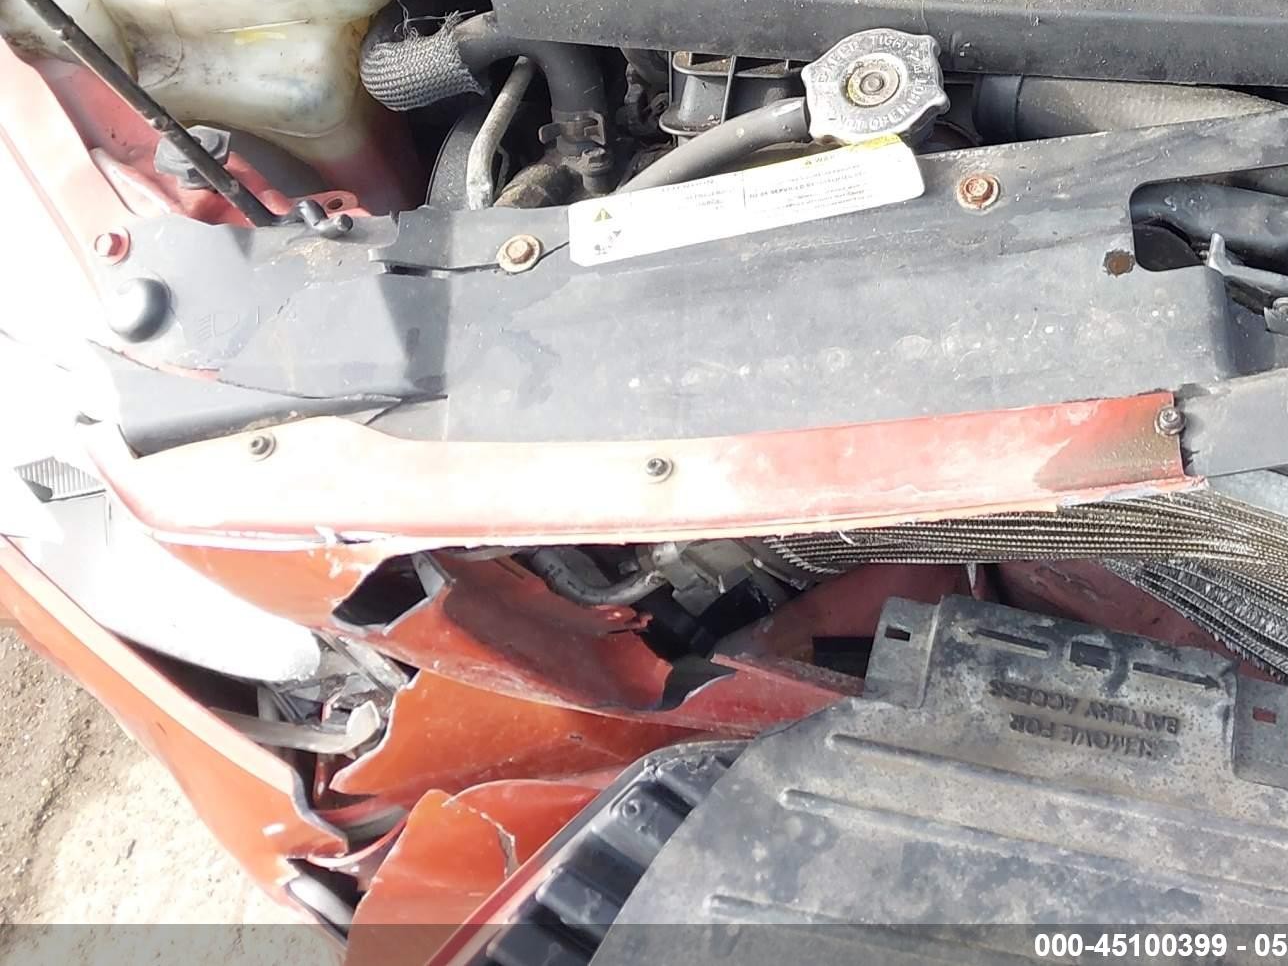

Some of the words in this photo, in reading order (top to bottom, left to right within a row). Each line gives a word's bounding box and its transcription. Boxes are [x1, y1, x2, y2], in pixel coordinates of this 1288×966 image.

[988, 679, 1080, 715] ACCESS
[1008, 712, 1054, 739] FOR
[1085, 701, 1181, 735] BATTERY
[1062, 724, 1153, 758] REMOVE
